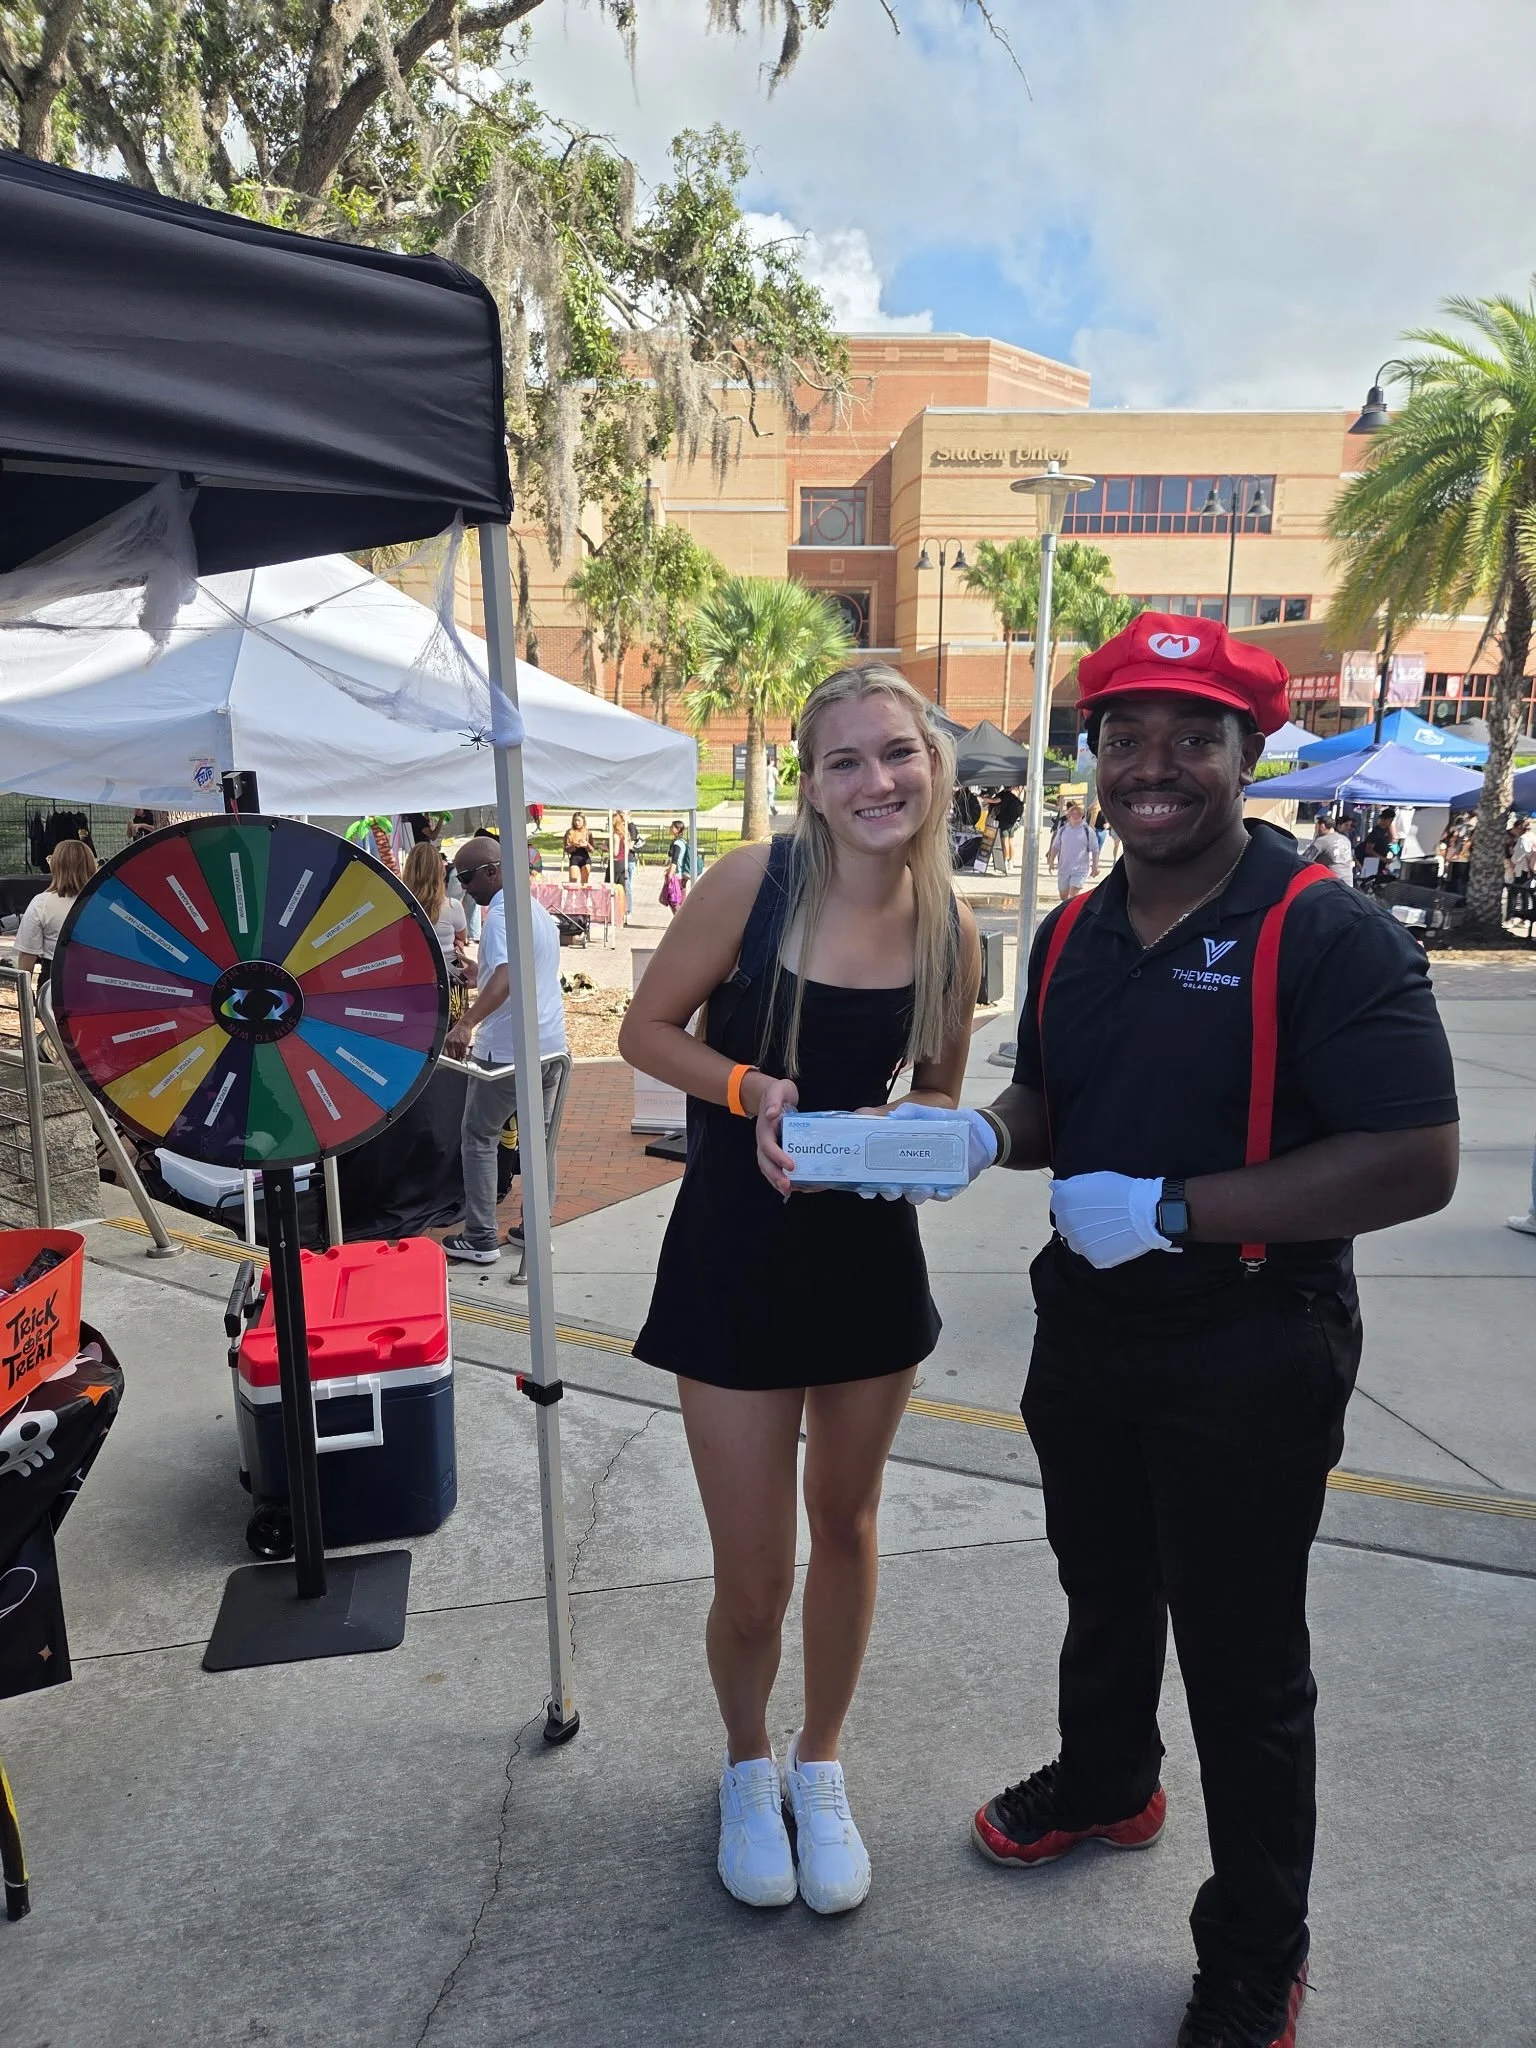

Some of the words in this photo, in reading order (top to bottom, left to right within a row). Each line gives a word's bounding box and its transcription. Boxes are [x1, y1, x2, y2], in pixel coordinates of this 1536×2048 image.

[934, 445, 1008, 464] Student
[1013, 444, 1073, 464] Union
[1157, 635, 1190, 653] M
[177, 889, 190, 905] AGAIN
[287, 895, 298, 912] VERGE
[295, 883, 304, 895] MUG
[187, 905, 198, 918] SPIN
[324, 924, 342, 938] VERGE
[340, 911, 360, 927] T-SHIRT
[156, 937, 174, 952] VERGE
[357, 964, 371, 972] SPIN
[370, 959, 386, 968] AGAIN
[104, 978, 128, 986] HOLDER
[1183, 983, 1218, 992] ORLANDO
[128, 1030, 146, 1038] AGAIN
[178, 1057, 192, 1071] VERGE
[349, 1056, 365, 1070] VERGE
[363, 1067, 374, 1076] HAT
[161, 1070, 178, 1086] T-SHIRT
[217, 1085, 228, 1102] VERGE
[315, 1081, 324, 1093] SPIN
[321, 1092, 332, 1107] AGAIN
[212, 1101, 220, 1113] MUG
[787, 1142, 850, 1155] SoundCore
[853, 1144, 861, 1155] 2
[899, 1150, 931, 1158] ANKER
[2, 1319, 60, 1391] TREAT
